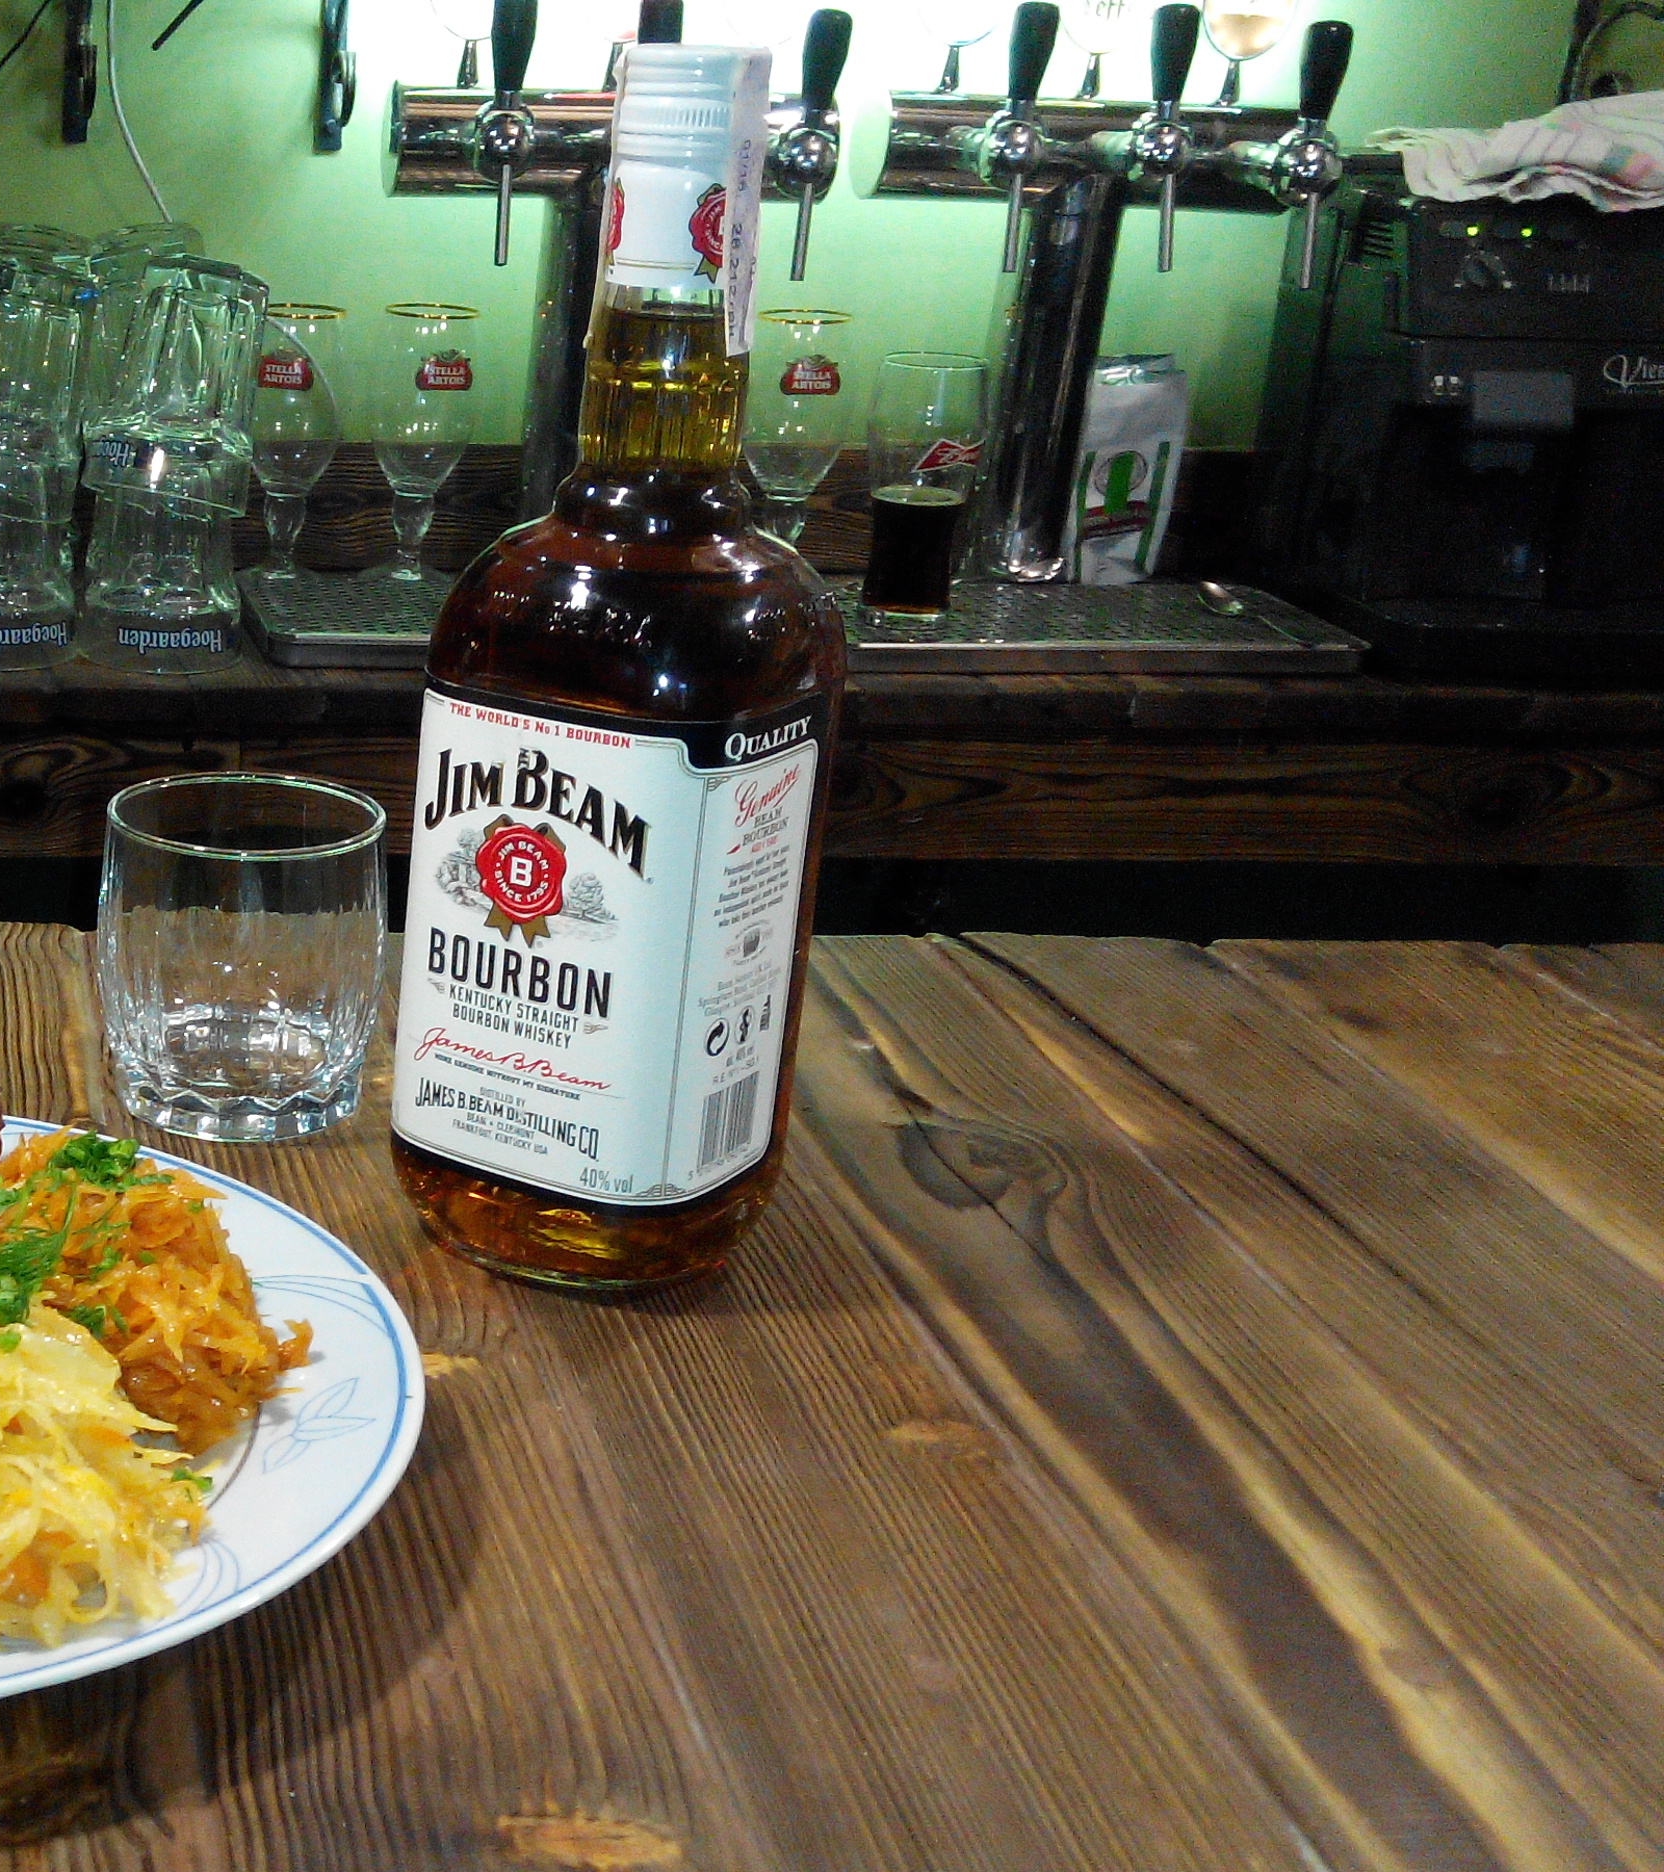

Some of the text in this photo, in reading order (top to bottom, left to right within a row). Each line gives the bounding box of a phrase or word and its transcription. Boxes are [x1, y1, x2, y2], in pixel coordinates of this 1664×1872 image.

[263, 373, 303, 385] ARTOIS
[265, 363, 302, 375] STELLA
[427, 375, 465, 386] ARTOIS
[428, 364, 465, 376] STELLA
[117, 626, 223, 655] Hoegaarden
[450, 702, 472, 717] THE
[554, 725, 561, 737] 1
[566, 727, 632, 748] BOURBON
[734, 763, 800, 828] Genuine
[424, 746, 652, 881] JIM BEAM
[498, 840, 550, 870] JIM BEAM
[494, 870, 549, 902] SINCE 1795
[509, 855, 534, 888] B
[428, 926, 612, 1019] BOURBON
[449, 983, 580, 1033] KENTUCKY STRAIGHT
[452, 1003, 572, 1049] BOURBON WHISKEY
[415, 1077, 455, 1108] JAMES
[469, 1094, 505, 1119] BEAM
[579, 1166, 634, 1194] 40% vol
